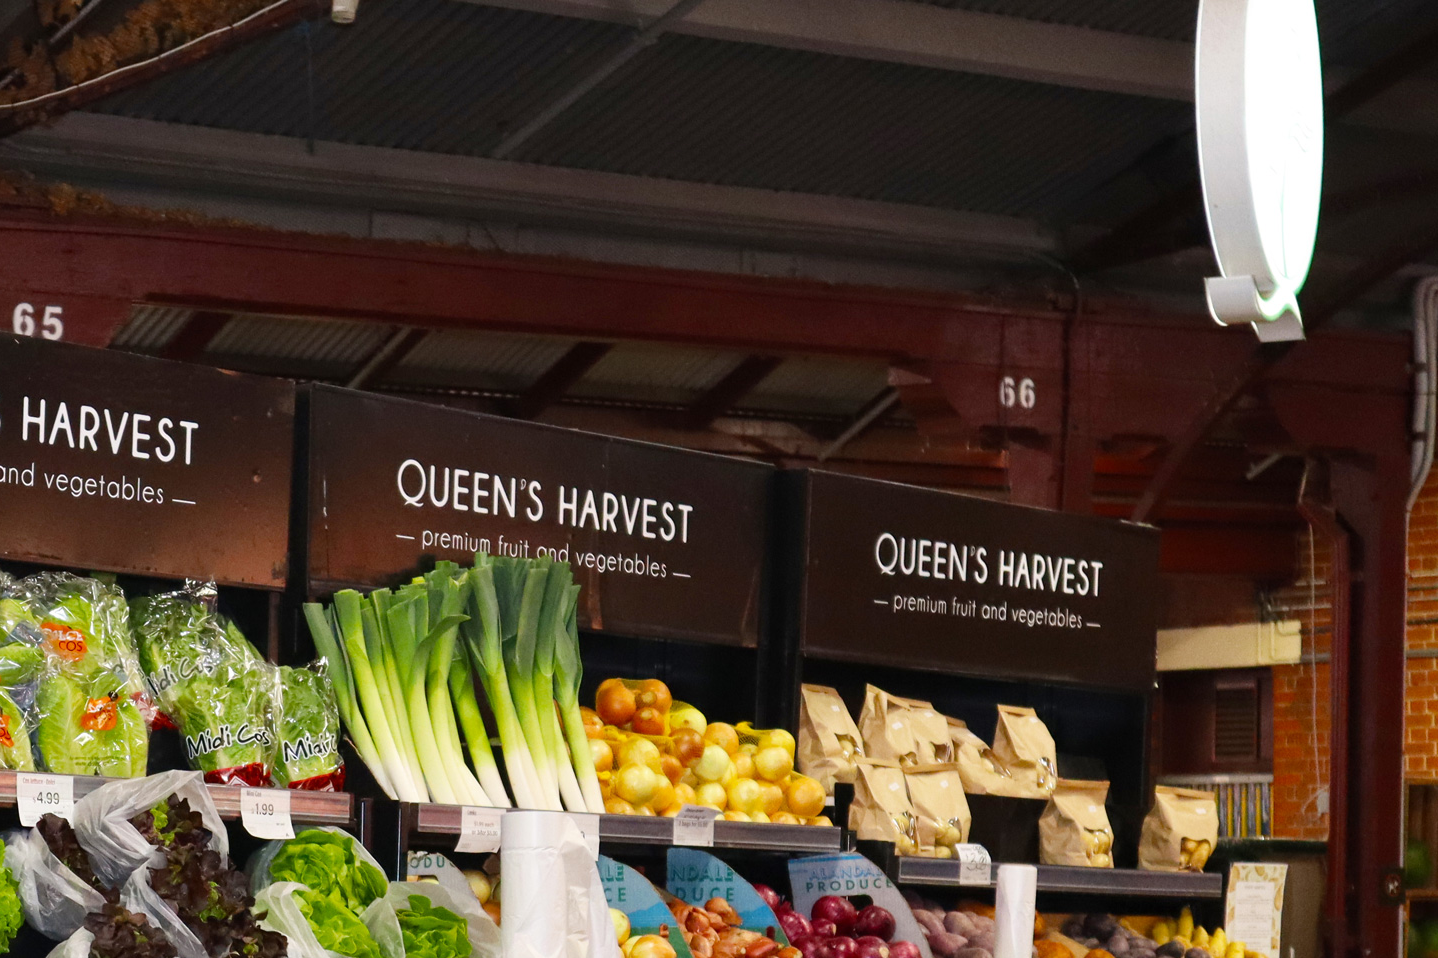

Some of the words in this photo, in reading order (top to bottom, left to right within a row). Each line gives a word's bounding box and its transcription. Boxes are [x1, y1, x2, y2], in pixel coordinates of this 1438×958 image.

[13, 303, 62, 340] 65
[1000, 376, 1036, 408] 66
[22, 397, 199, 465] HARVEST
[45, 472, 164, 504] vegetables
[397, 459, 544, 521] QUEEN'S
[559, 485, 694, 543] HARVEST
[422, 530, 491, 552] premium
[498, 535, 530, 559] fruit
[537, 543, 569, 563] and
[576, 551, 667, 577] vegetables
[875, 532, 988, 584] QUEEN'S
[999, 550, 1104, 597] HARVEST
[893, 595, 947, 614] premium
[952, 597, 977, 617] fruit
[981, 602, 1007, 621] and
[1012, 608, 1083, 629] vegetables
[58, 640, 83, 651] COS
[186, 724, 232, 760] Midi
[236, 722, 271, 747] Cos
[255, 803, 275, 816] 1.99
